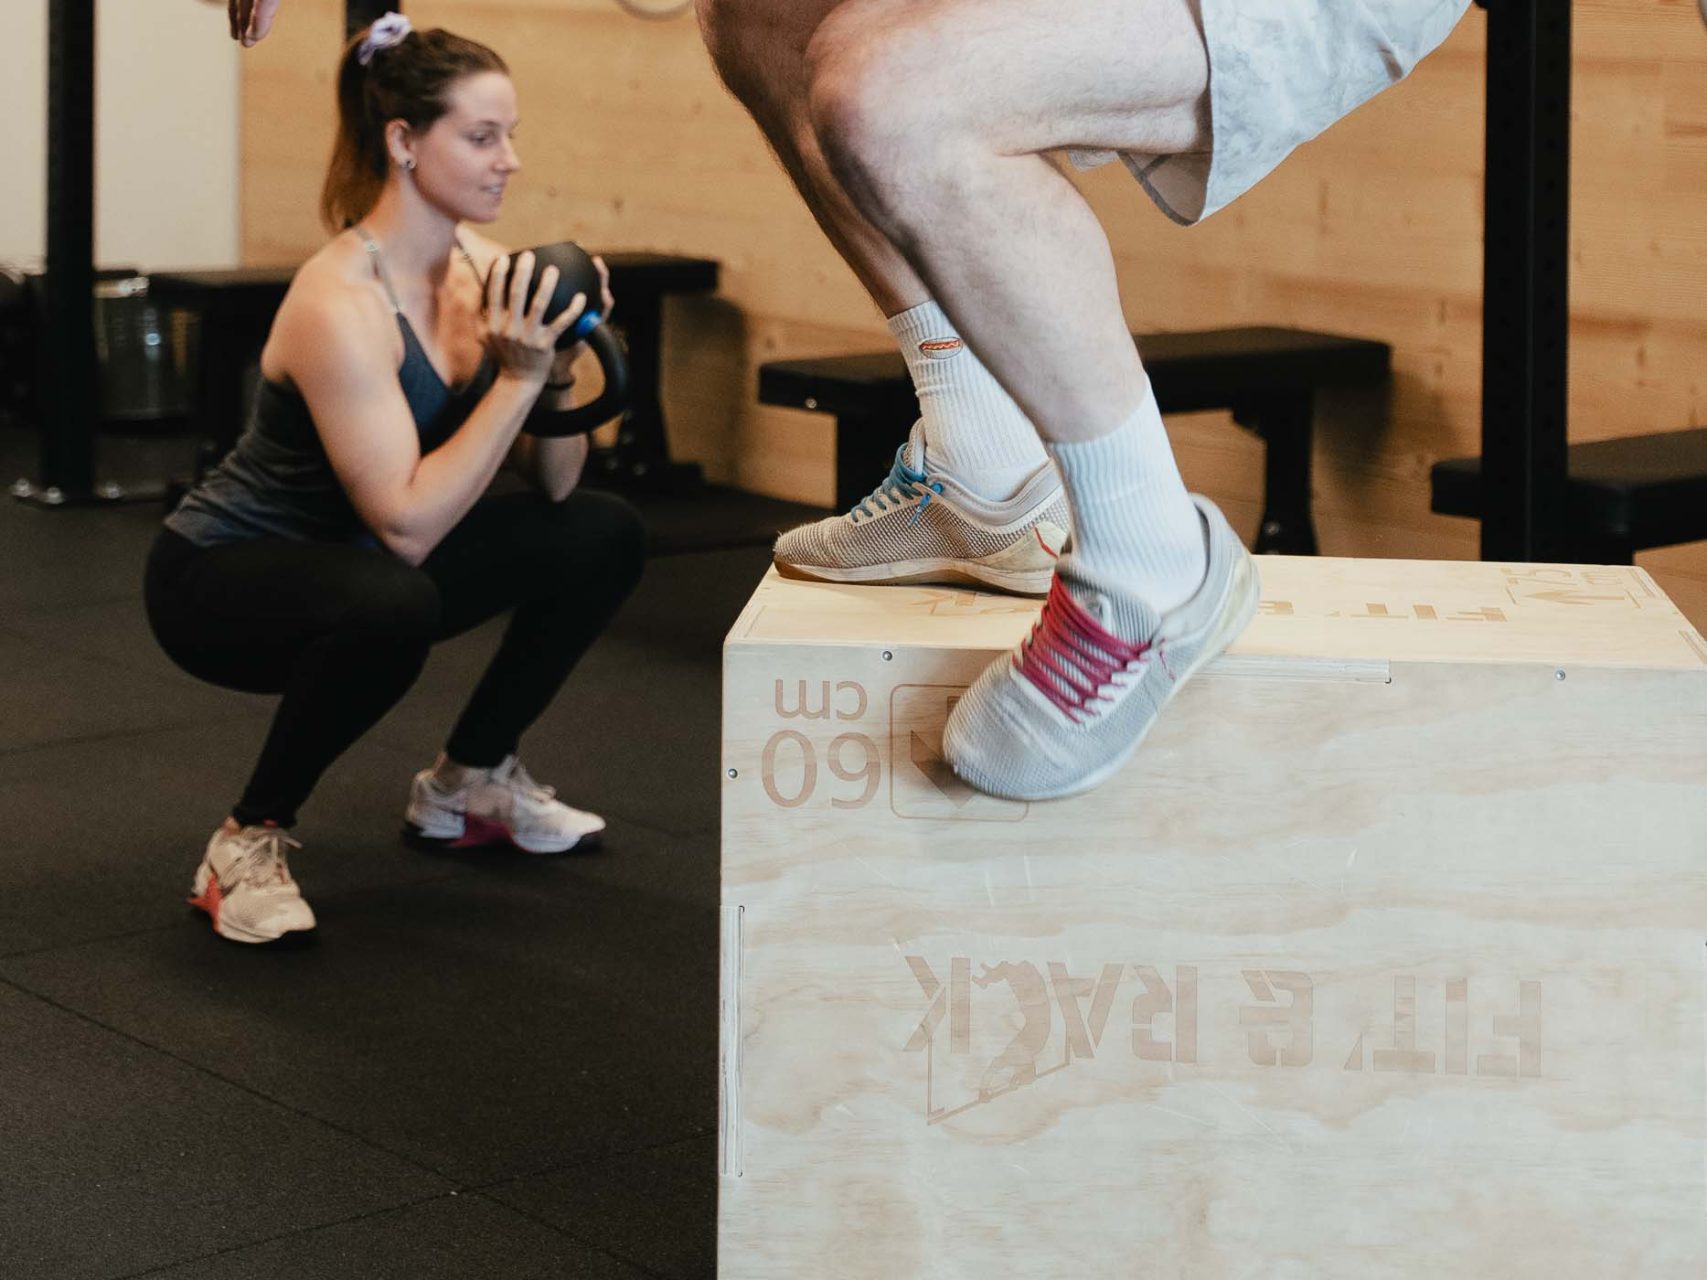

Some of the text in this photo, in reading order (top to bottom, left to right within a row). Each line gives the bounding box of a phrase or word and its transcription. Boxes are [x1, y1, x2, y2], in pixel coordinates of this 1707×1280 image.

[775, 678, 868, 721] cm
[761, 729, 881, 809] 60
[904, 955, 1198, 1102] RACK
